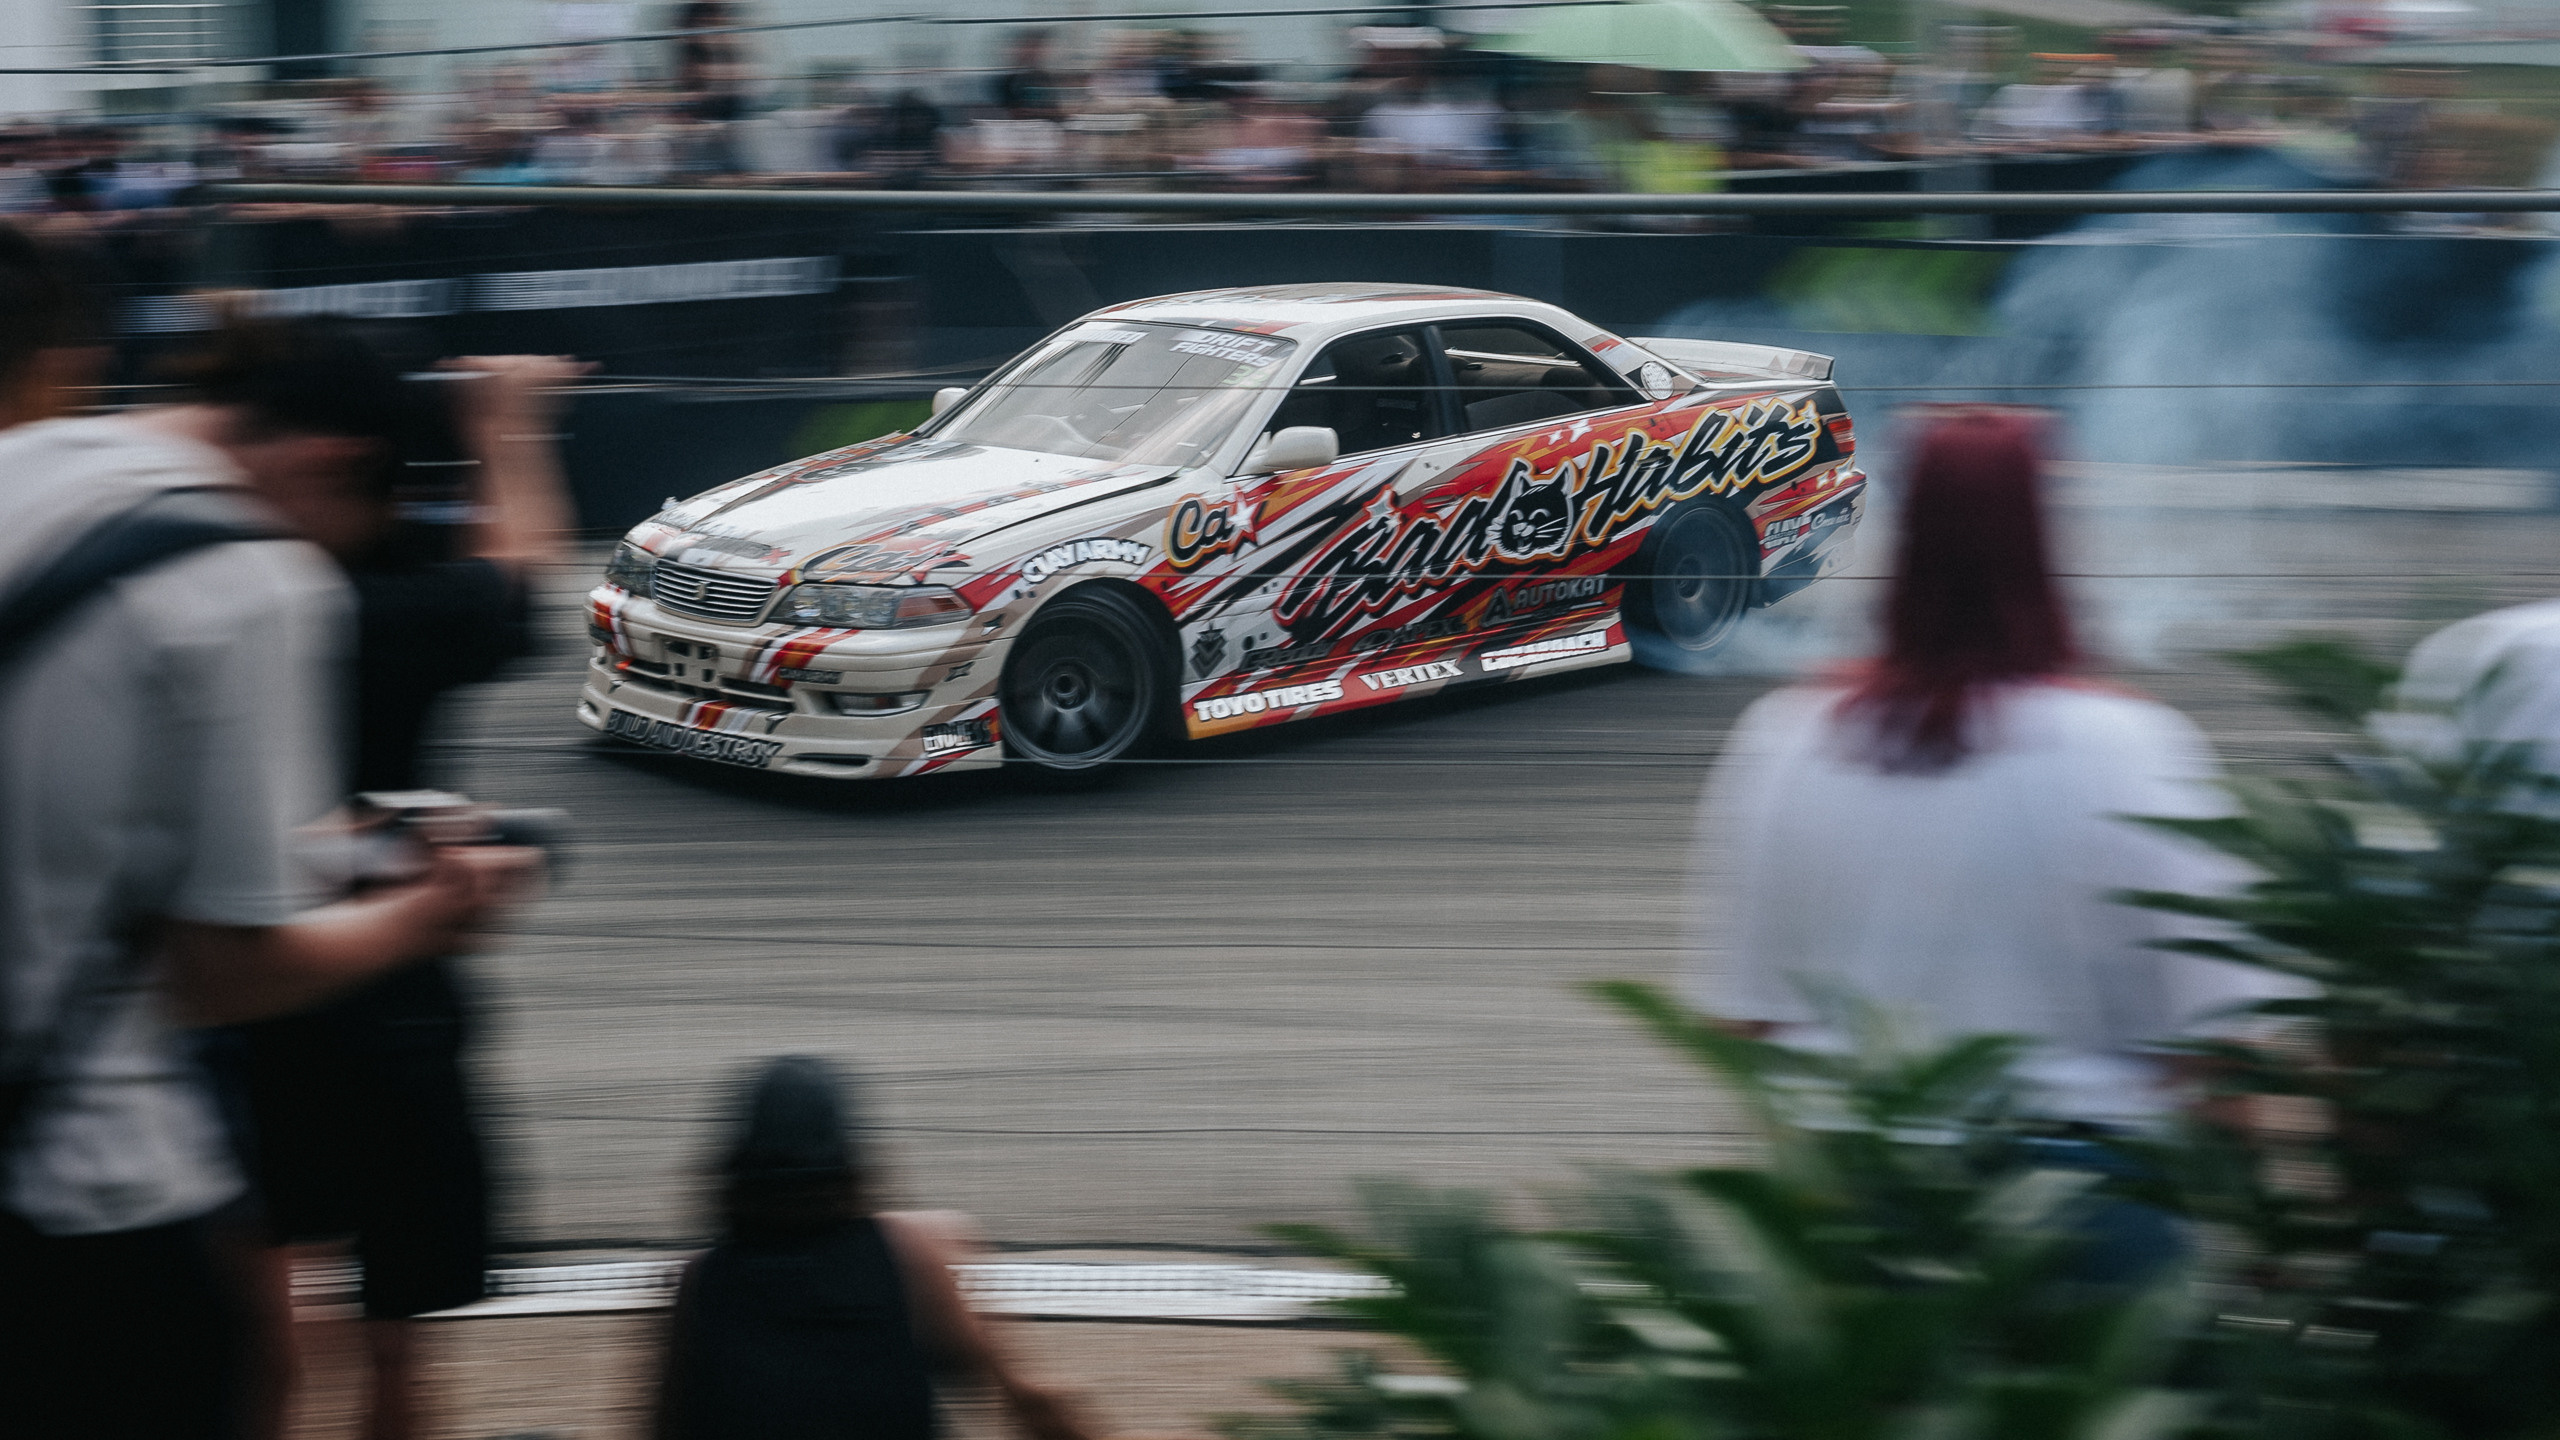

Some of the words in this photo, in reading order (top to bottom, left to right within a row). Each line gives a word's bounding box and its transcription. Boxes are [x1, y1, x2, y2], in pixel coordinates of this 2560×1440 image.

[1169, 341, 1279, 368] FIGHTERS
[1197, 331, 1278, 353] DRIFT
[1572, 399, 1819, 543] Habits
[1514, 573, 1608, 610] AUTOKAT
[1358, 658, 1464, 692] VERTEX
[1193, 692, 1266, 721] TOYO
[1262, 679, 1344, 709] TIRES
[682, 730, 785, 768] DESTROY
